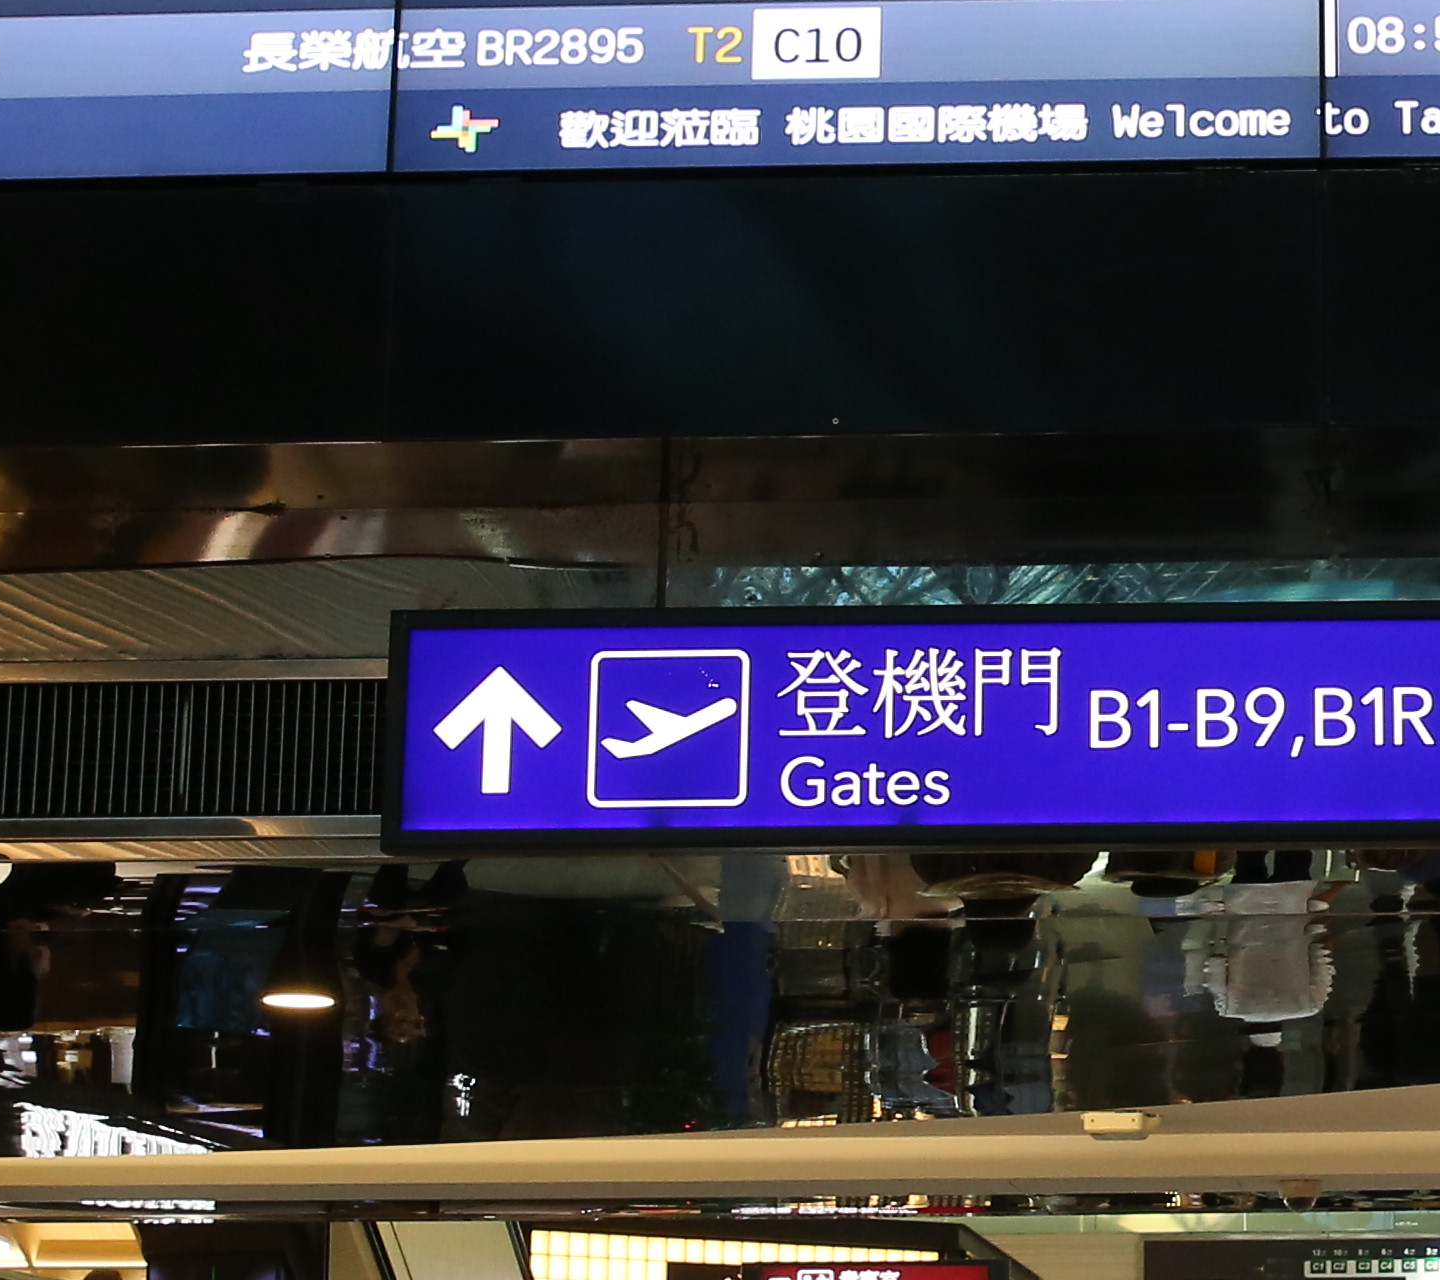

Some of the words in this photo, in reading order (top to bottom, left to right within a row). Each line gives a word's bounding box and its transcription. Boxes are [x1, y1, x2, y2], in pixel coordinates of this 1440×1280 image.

[784, 103, 1089, 146] 桃園國際機場
[1111, 103, 1291, 138] Welcome
[1316, 102, 1370, 135] to
[777, 647, 1062, 739] 登機門
[1090, 686, 1435, 758] B1-B9,B1R
[780, 755, 950, 807] Gates
